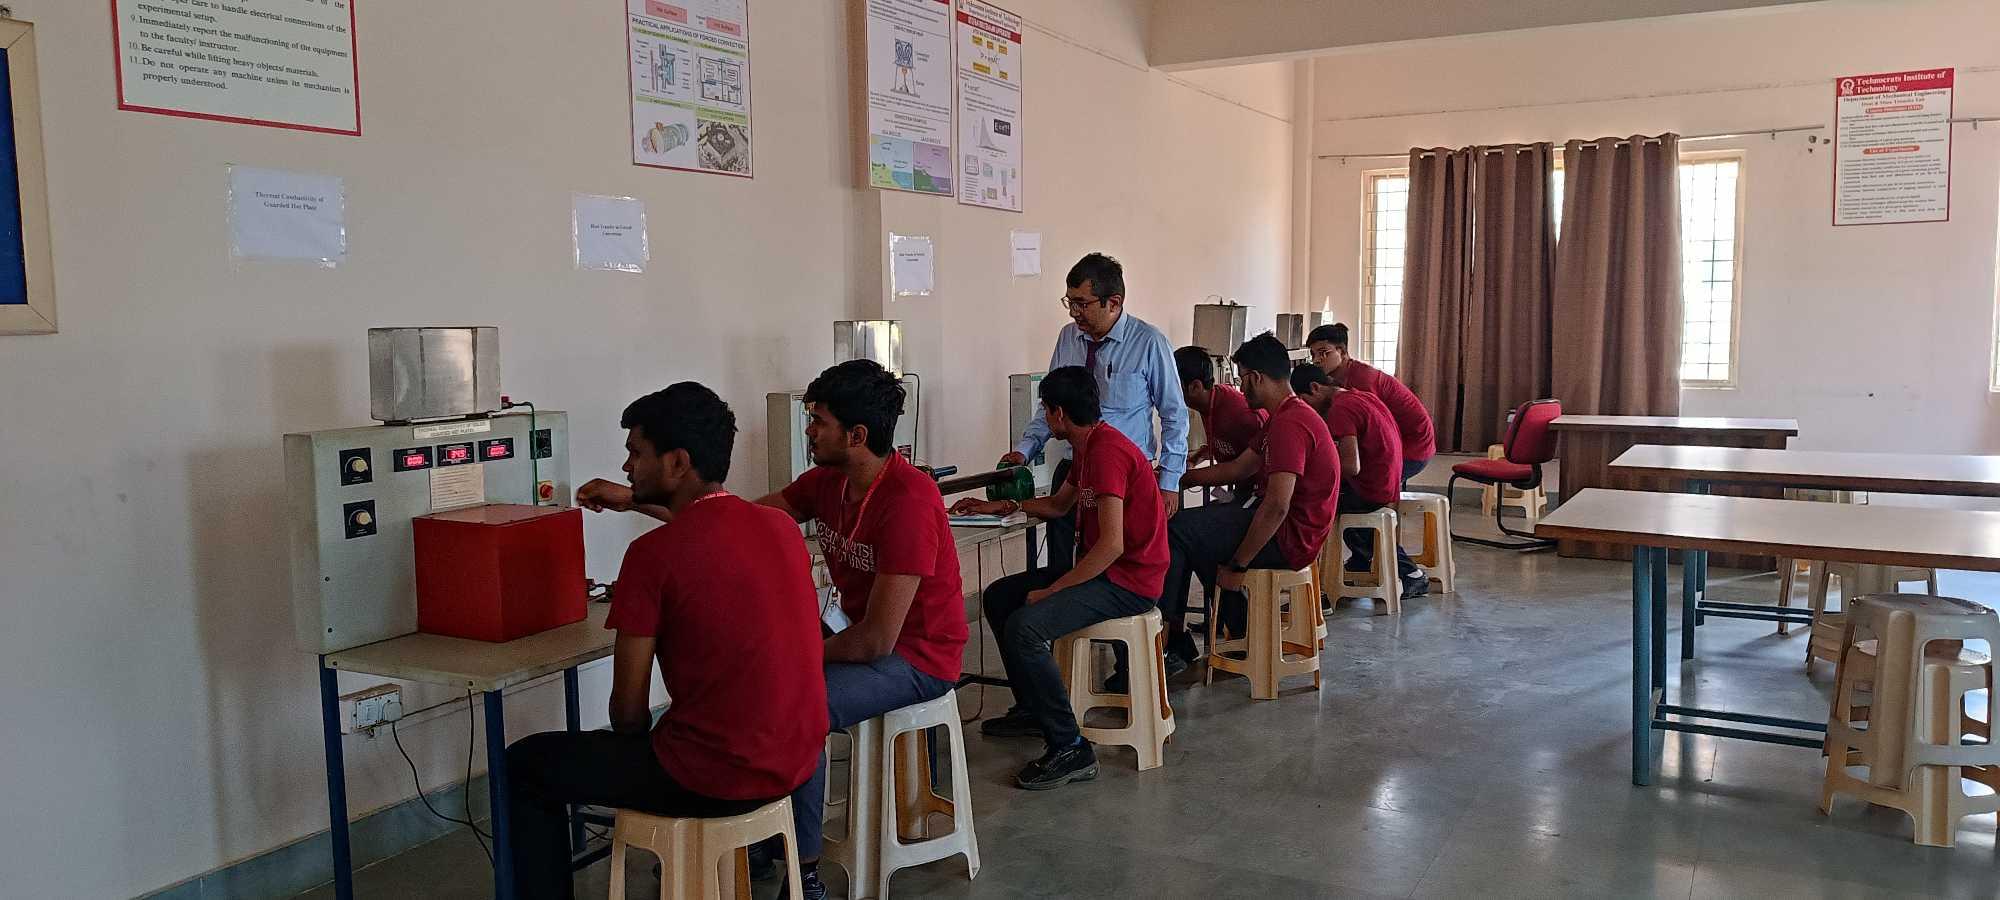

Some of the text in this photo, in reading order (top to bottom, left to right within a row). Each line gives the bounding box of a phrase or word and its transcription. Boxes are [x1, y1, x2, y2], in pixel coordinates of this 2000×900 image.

[137, 3, 192, 18] experimental
[222, 3, 249, 15] handle
[250, 8, 282, 21] electrical
[284, 17, 325, 29] connections
[336, 25, 347, 33] the
[139, 15, 191, 32] Immediately
[192, 26, 218, 36] report
[219, 29, 232, 38] the
[234, 32, 290, 50] malfunctioning
[291, 41, 299, 49] of
[300, 43, 312, 52] the
[312, 46, 348, 58] equipment
[140, 30, 149, 38] to
[151, 32, 165, 41] the
[141, 43, 152, 52] Be
[153, 46, 183, 57] careful
[184, 50, 207, 61] while
[207, 53, 232, 66] lifting
[232, 57, 255, 69] heavy
[142, 56, 156, 67] Do
[160, 61, 174, 69] not
[178, 64, 210, 74] operate
[213, 68, 227, 77] any
[231, 71, 263, 82] machine
[303, 81, 342, 94] mechanism
[142, 72, 178, 85] properly
[1856, 71, 1947, 86] Technocrats Institute of
[1856, 84, 1899, 95] Technology
